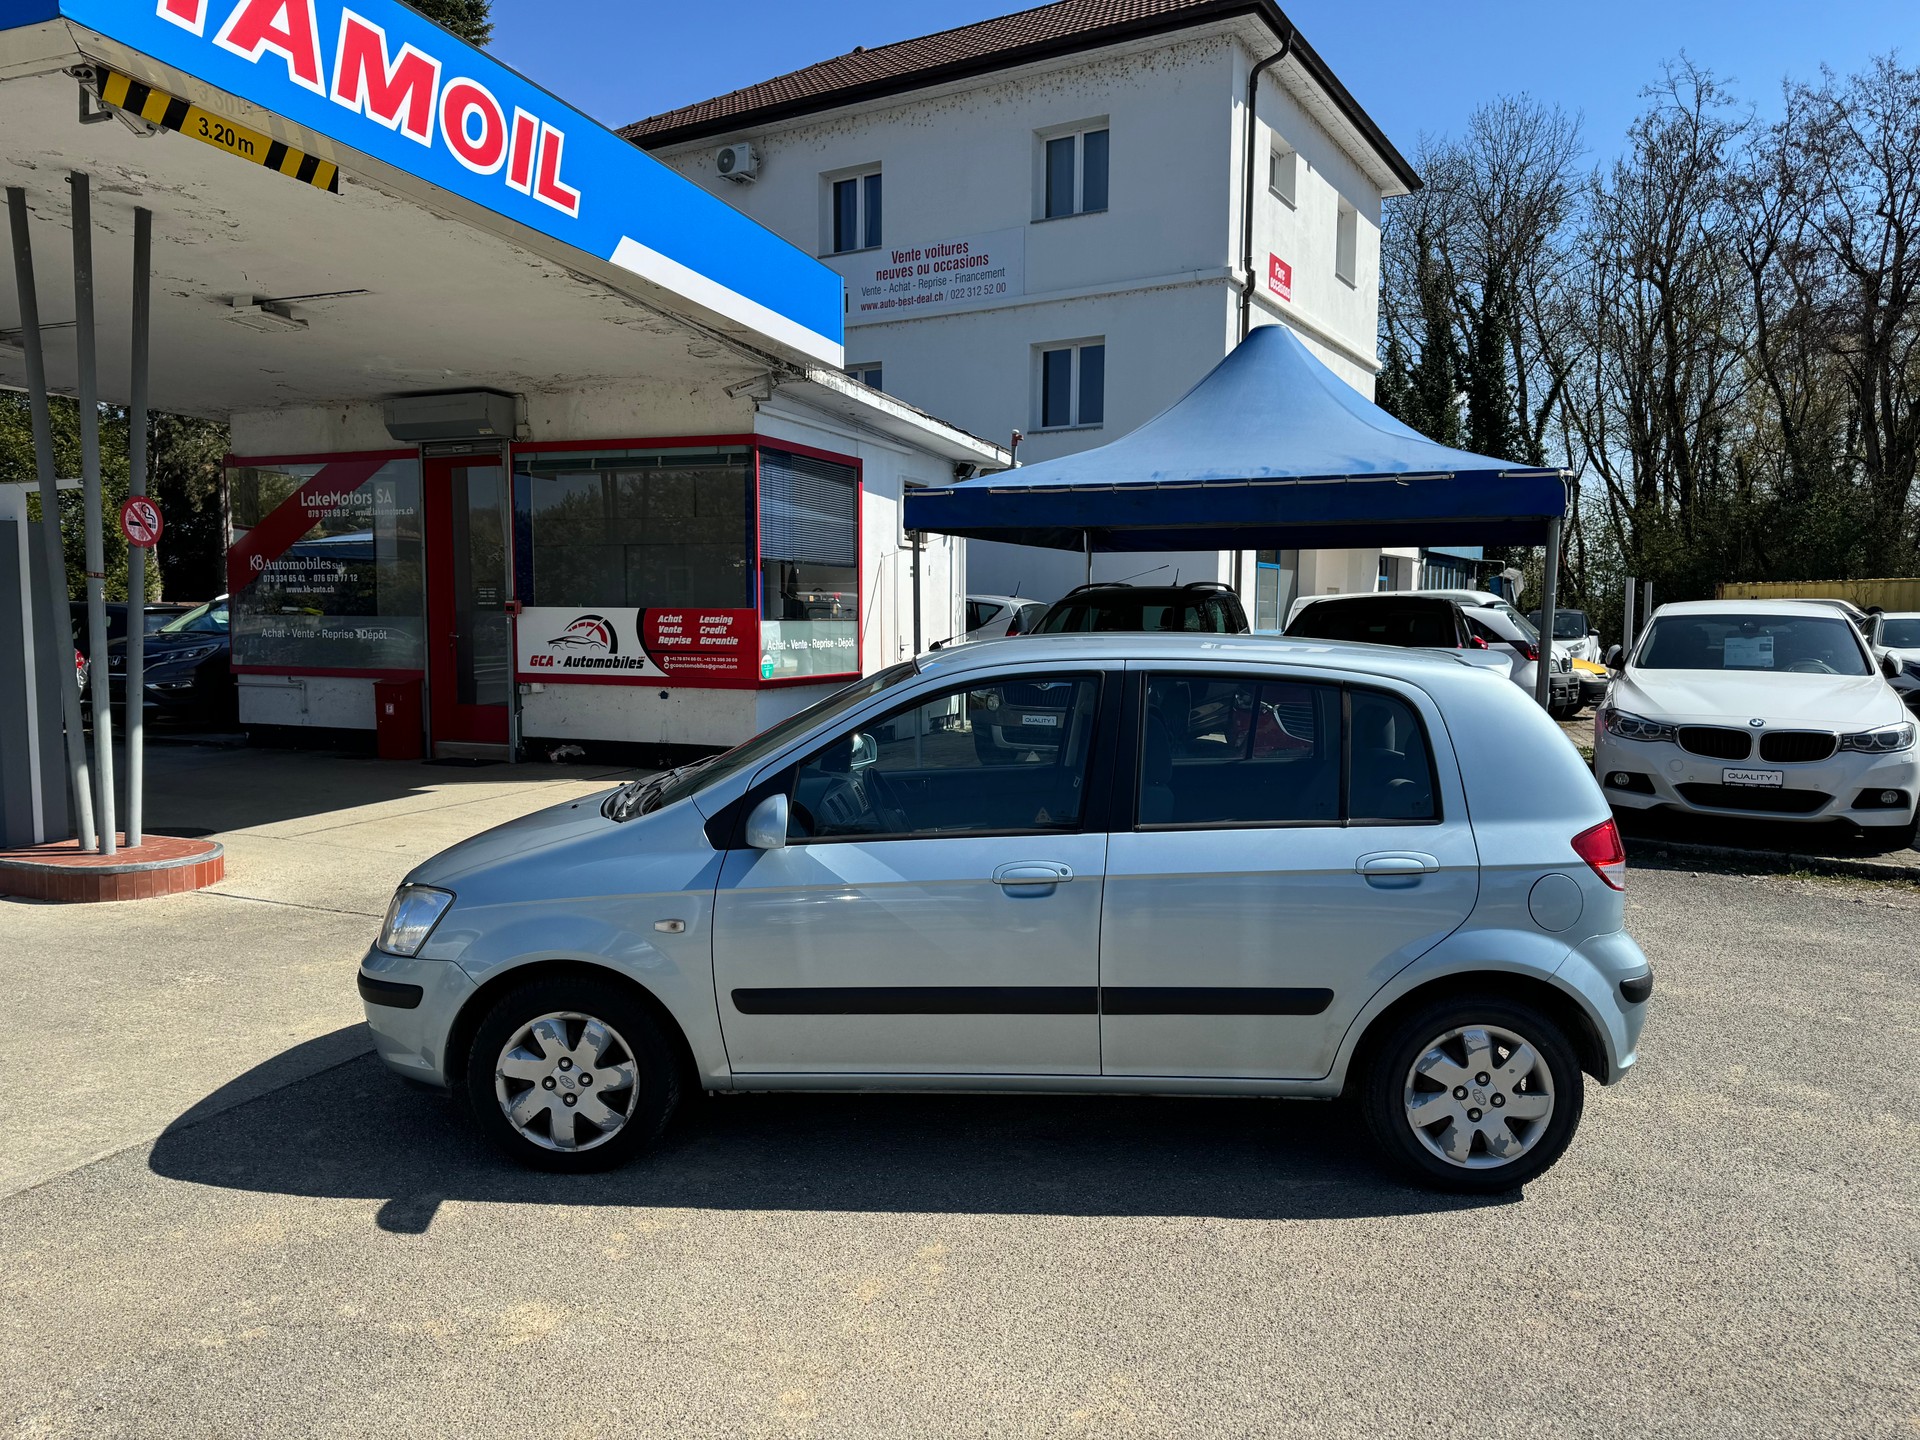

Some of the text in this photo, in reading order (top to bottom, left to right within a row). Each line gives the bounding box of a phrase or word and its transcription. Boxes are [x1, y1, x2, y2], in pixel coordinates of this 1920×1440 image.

[156, 0, 581, 219] AMOIL
[198, 117, 254, 155] 3.20 m
[891, 242, 969, 264] Vente voitures
[876, 254, 989, 281] neuves ou occasions
[861, 286, 882, 297] Vente
[888, 282, 910, 294] Achat
[918, 276, 947, 290] Reprise
[955, 267, 1006, 284] Financement
[860, 292, 944, 312] www.auto-best-deal.ch
[950, 288, 965, 300] 022
[967, 286, 982, 298] 312
[984, 284, 994, 295] 52
[996, 282, 1006, 293] 00
[301, 488, 392, 506] LakeMotors SA
[308, 510, 319, 518] 079
[321, 510, 332, 518] 753
[333, 509, 340, 517] 69
[342, 508, 350, 517] 62
[657, 615, 682, 623] Achat
[699, 615, 733, 625] Leasing
[261, 628, 285, 638] Achat
[292, 628, 315, 638] Vente
[322, 629, 354, 640] Reprise
[361, 629, 387, 641] Dépôt
[700, 626, 727, 634] Credit
[658, 636, 692, 646] Reprise
[700, 636, 738, 645] Garantie
[767, 640, 786, 650] Achat
[791, 640, 808, 650] Vente
[812, 638, 833, 650] Reprise
[838, 637, 854, 648] Dépôt
[530, 655, 554, 667] GCA
[563, 656, 644, 669] Automobiles
